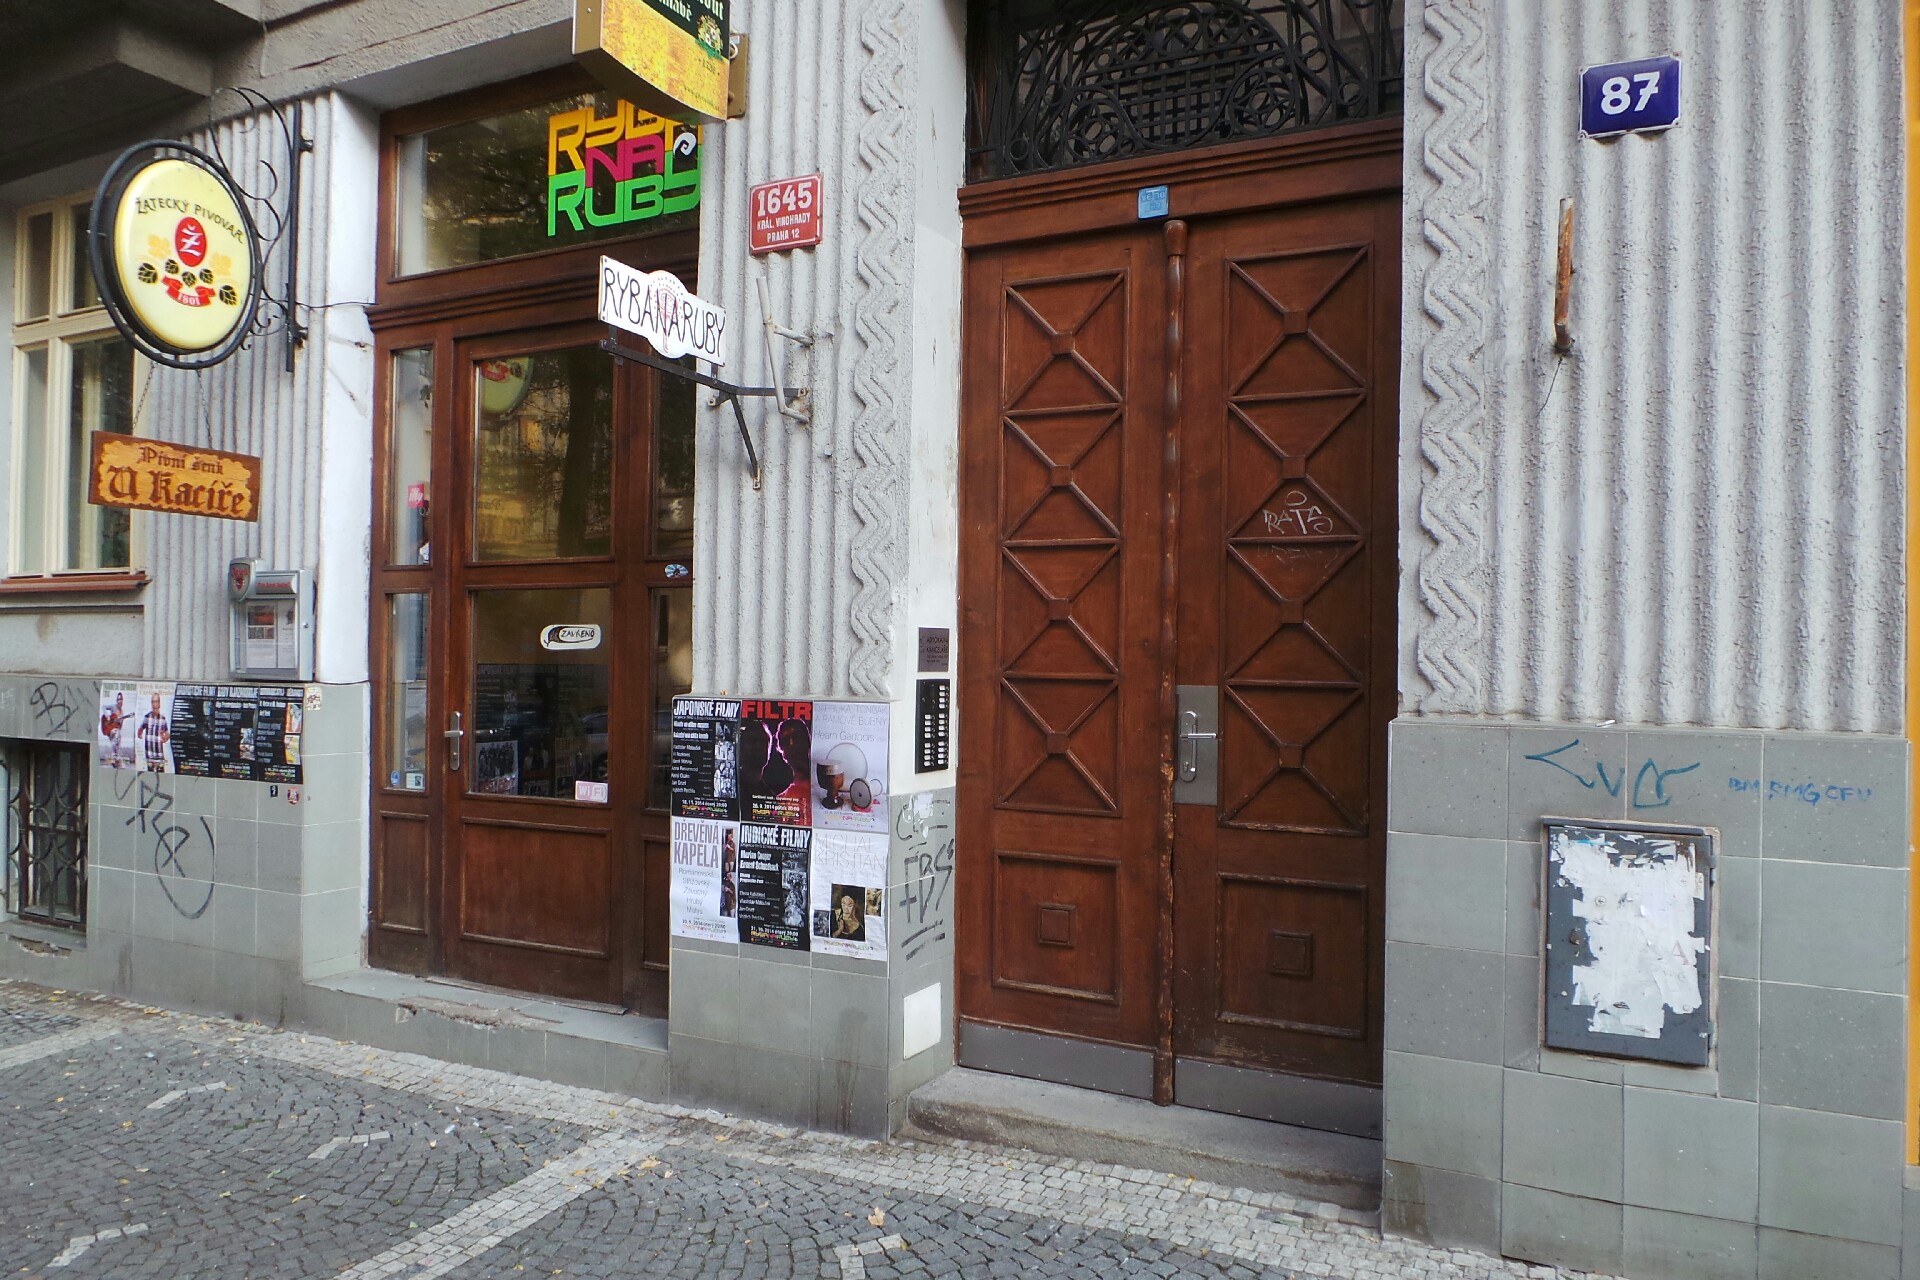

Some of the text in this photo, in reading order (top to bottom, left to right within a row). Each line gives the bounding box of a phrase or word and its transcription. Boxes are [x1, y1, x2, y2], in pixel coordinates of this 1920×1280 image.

[697, 0, 724, 21] out
[1601, 71, 1660, 115] 87
[585, 134, 665, 188] NA
[548, 144, 702, 236] RUBY
[758, 181, 812, 217] 1645
[135, 197, 243, 244] ŽATECKÝ PIVOVAR
[757, 212, 811, 231] KRÁL. VINOHRADY
[767, 228, 800, 243] PRAHA 12
[178, 293, 201, 306] 1801
[137, 446, 186, 469] Pivní
[107, 465, 246, 515] U Kacíře
[715, 702, 740, 718] FILMY
[741, 701, 812, 720] FILTR
[674, 818, 719, 844] DŘEVĚNÁ
[741, 824, 779, 846] INDICKÉ
[781, 828, 810, 849] FILMY
[815, 833, 874, 854] MICHAL
[674, 841, 719, 869] KAPELA
